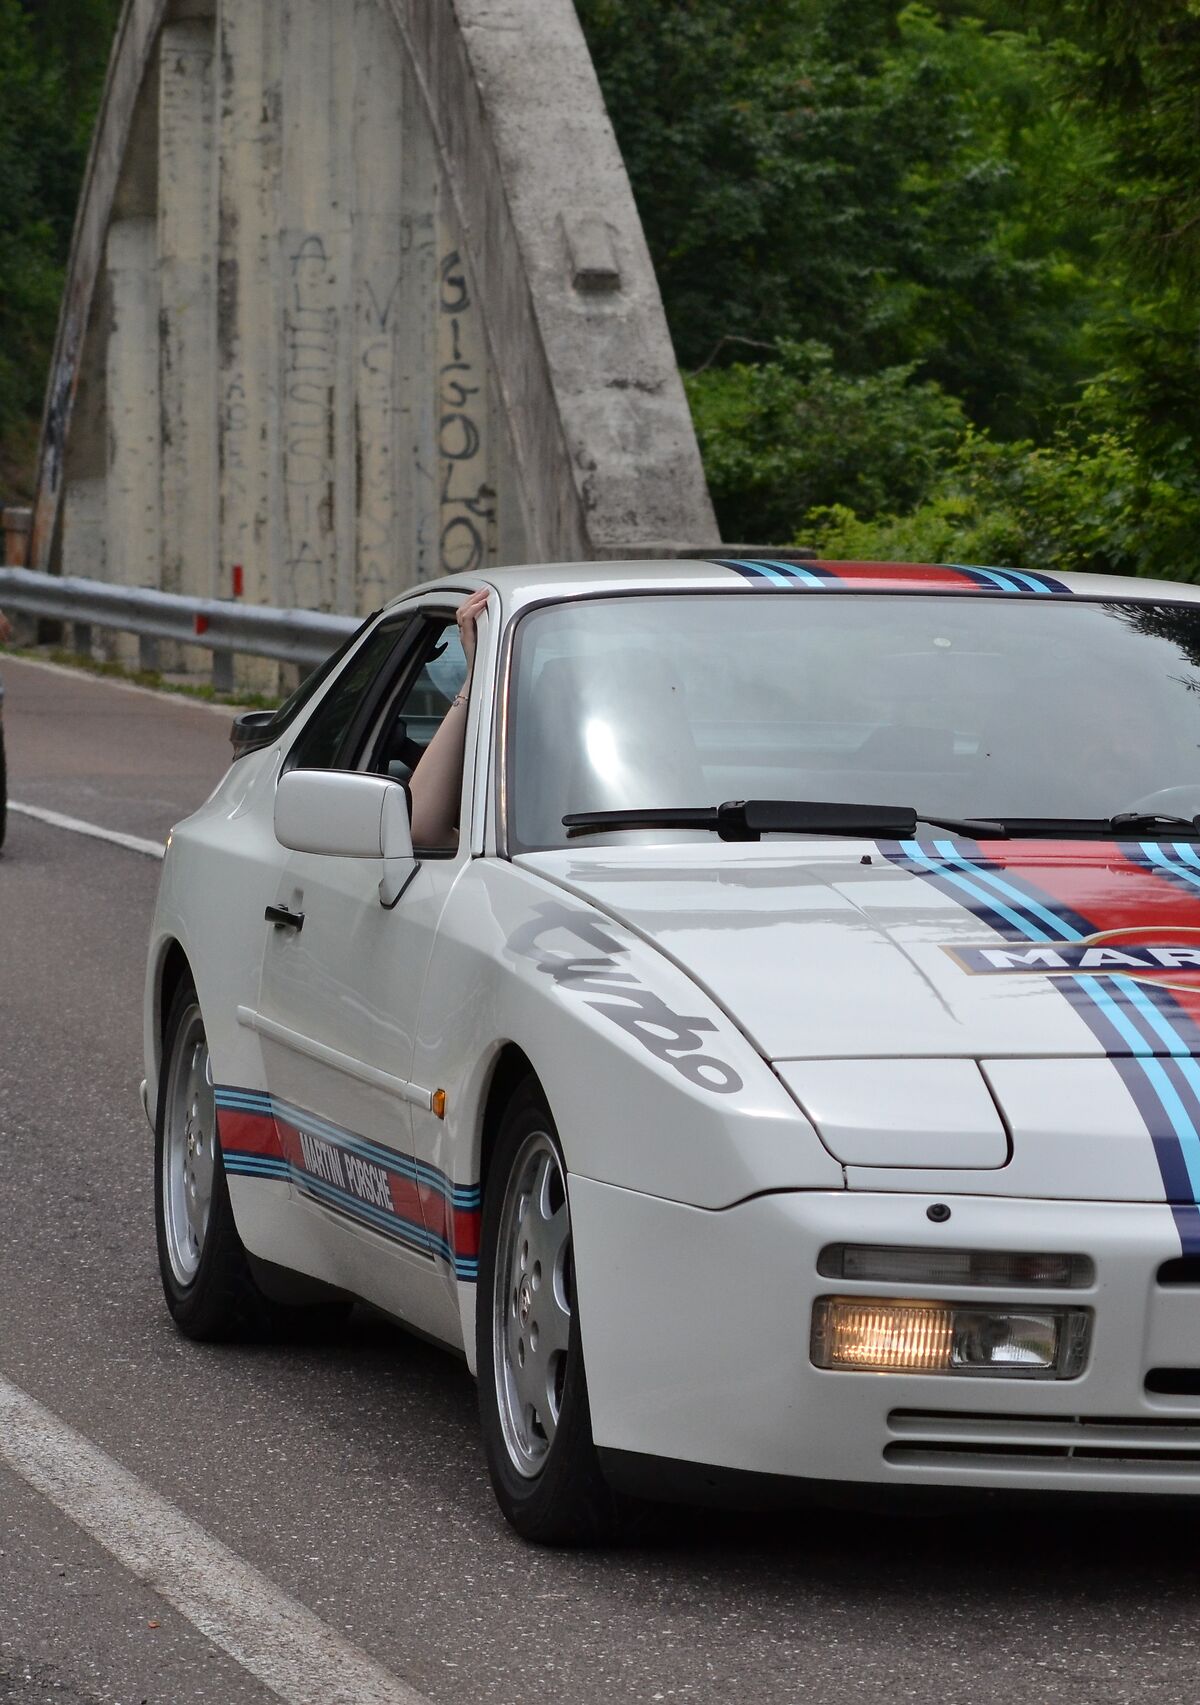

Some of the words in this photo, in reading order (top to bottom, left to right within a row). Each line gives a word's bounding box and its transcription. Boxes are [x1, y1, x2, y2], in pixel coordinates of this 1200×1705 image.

[504, 900, 744, 1094] turbo
[299, 1131, 345, 1188] MARTINI
[343, 1152, 395, 1212] PORSCHE
